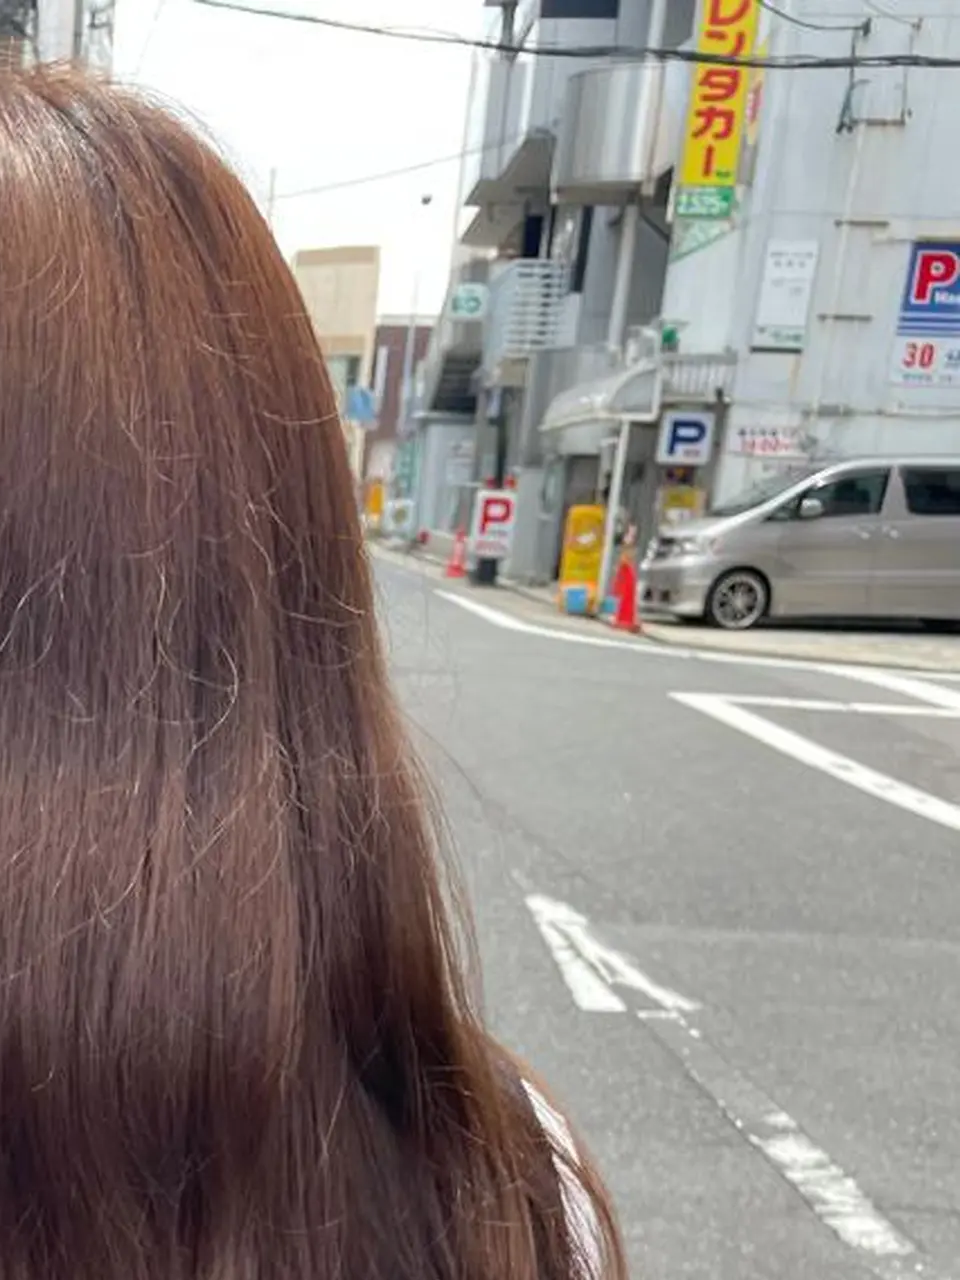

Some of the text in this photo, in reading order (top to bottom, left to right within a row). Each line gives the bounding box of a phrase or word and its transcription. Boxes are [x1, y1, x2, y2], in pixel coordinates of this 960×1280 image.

[691, 0, 752, 178] レンタカー
[911, 252, 958, 303] P
[902, 342, 935, 370] 30
[668, 420, 707, 456] P
[481, 498, 514, 535] P
